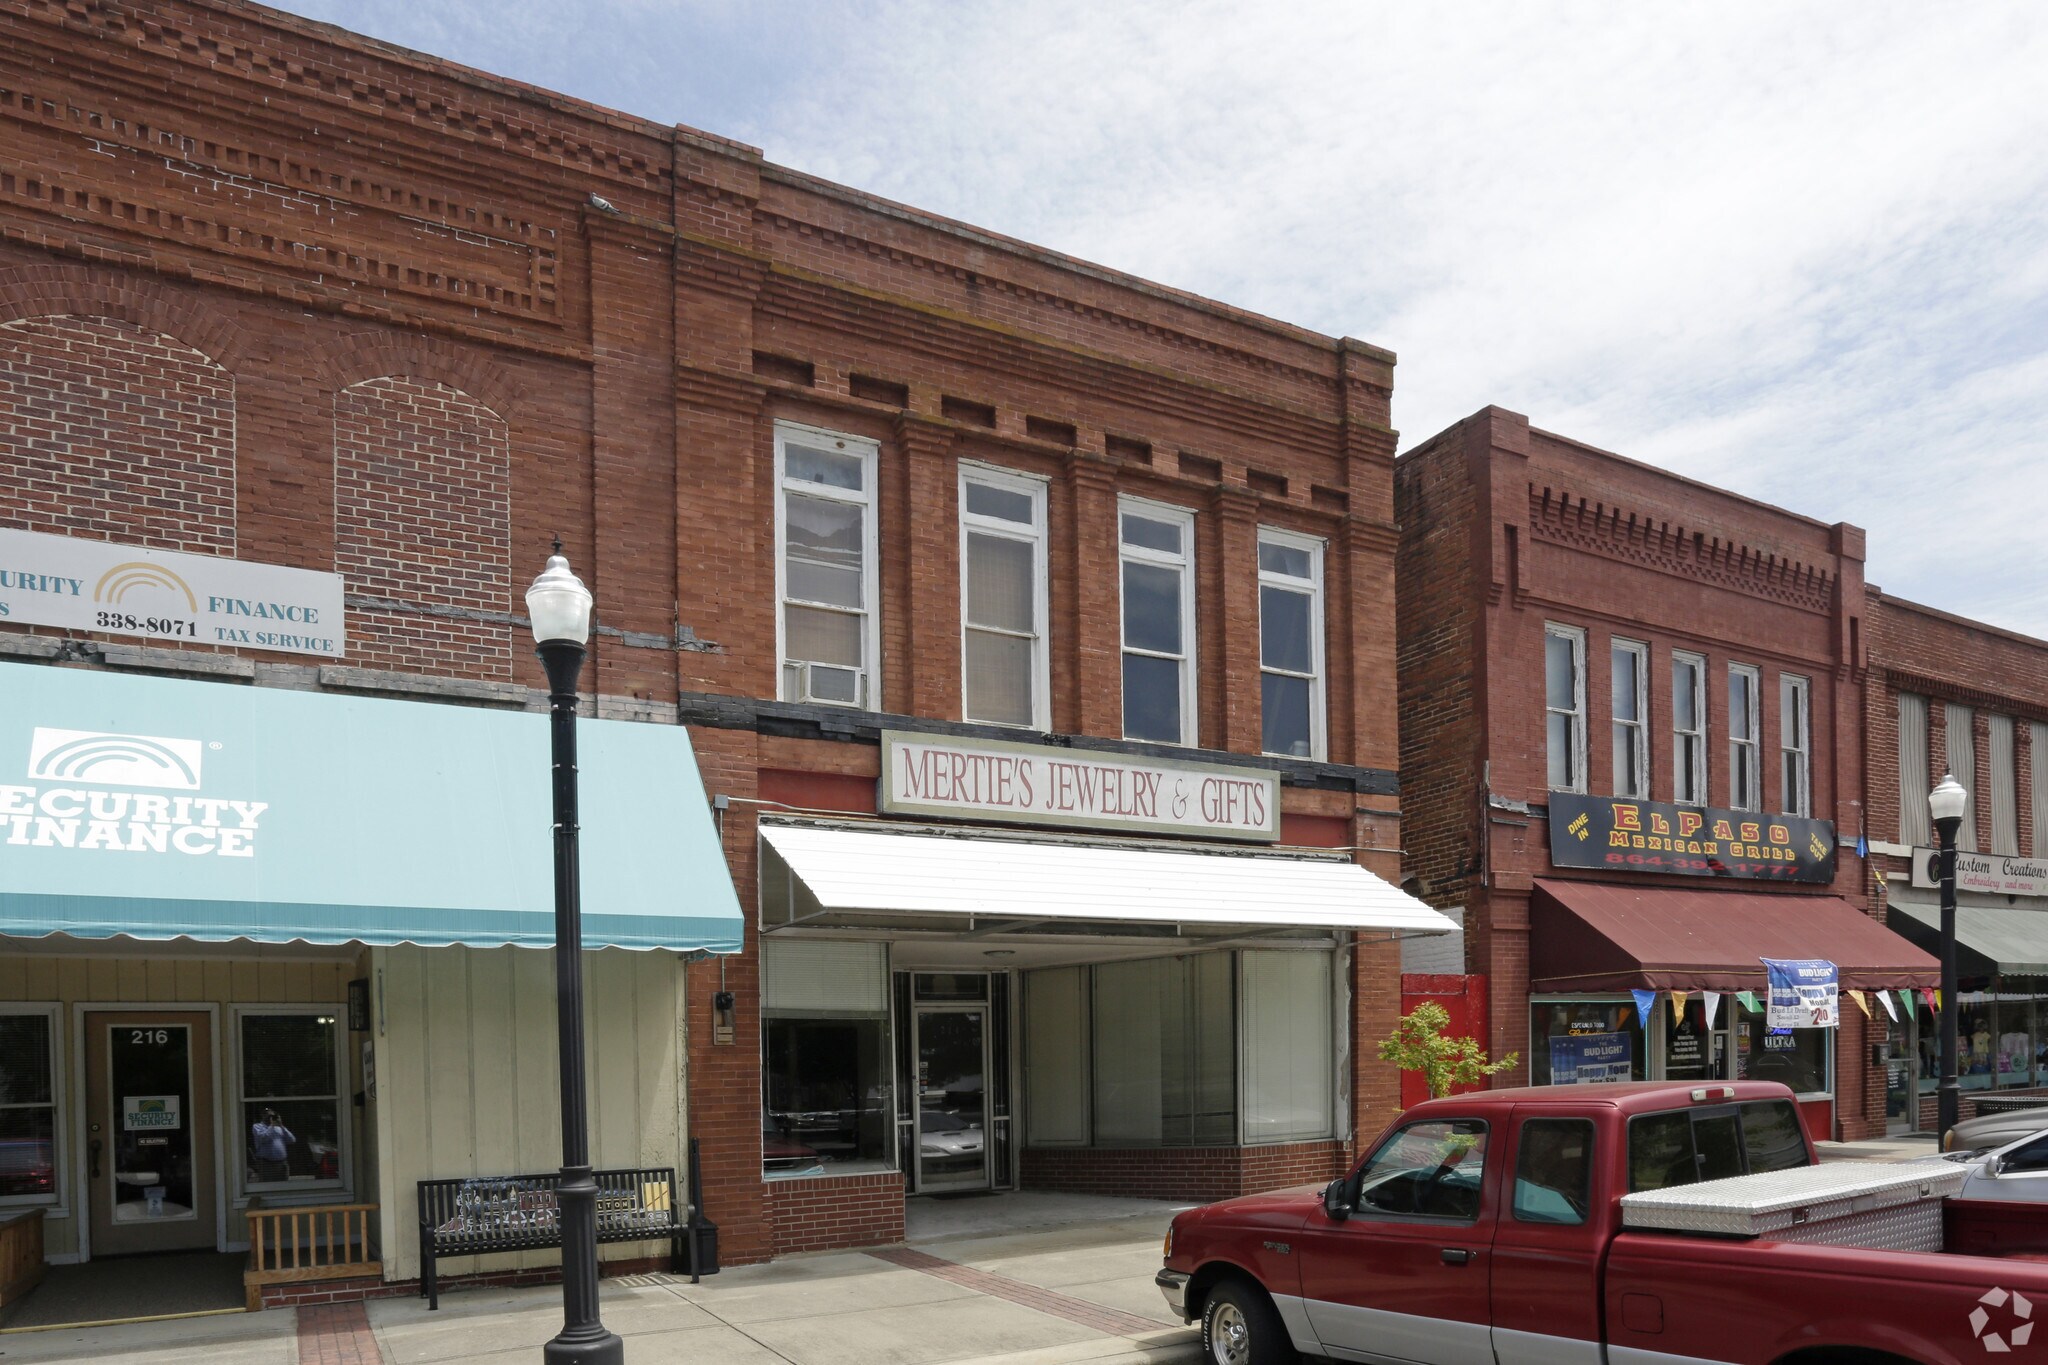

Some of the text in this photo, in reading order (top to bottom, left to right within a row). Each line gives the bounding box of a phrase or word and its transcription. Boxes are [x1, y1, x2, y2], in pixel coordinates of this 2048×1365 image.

[208, 596, 319, 624] FINANCE
[97, 611, 197, 637] 338-8071
[215, 627, 334, 652] TAX SERVICE
[902, 747, 1264, 826] MERTIE'S JEWELRY & GIFTS
[1568, 812, 1589, 835] DINE
[1577, 827, 1589, 841] IN
[0, 814, 254, 857] INANCE
[1609, 831, 1796, 861] MEXICAN GRILL
[1810, 832, 1828, 856] TAKE
[1810, 844, 1824, 862] OUT
[1605, 853, 1800, 875] 864-392-1777
[2003, 858, 2047, 879] Creations
[1963, 873, 2033, 891] Embroidery and more
[1799, 968, 1815, 977] BUD
[131, 1029, 168, 1045] 216
[1764, 1036, 1796, 1048] ULTRA
[1584, 1045, 1623, 1057] BUD LIGHT
[1577, 1064, 1607, 1079] Happy
[1607, 1064, 1630, 1076] Hour
[127, 1112, 176, 1120] SECURITY
[130, 1119, 175, 1127] FINANCE
[1203, 1300, 1216, 1351] UNIROYAL
